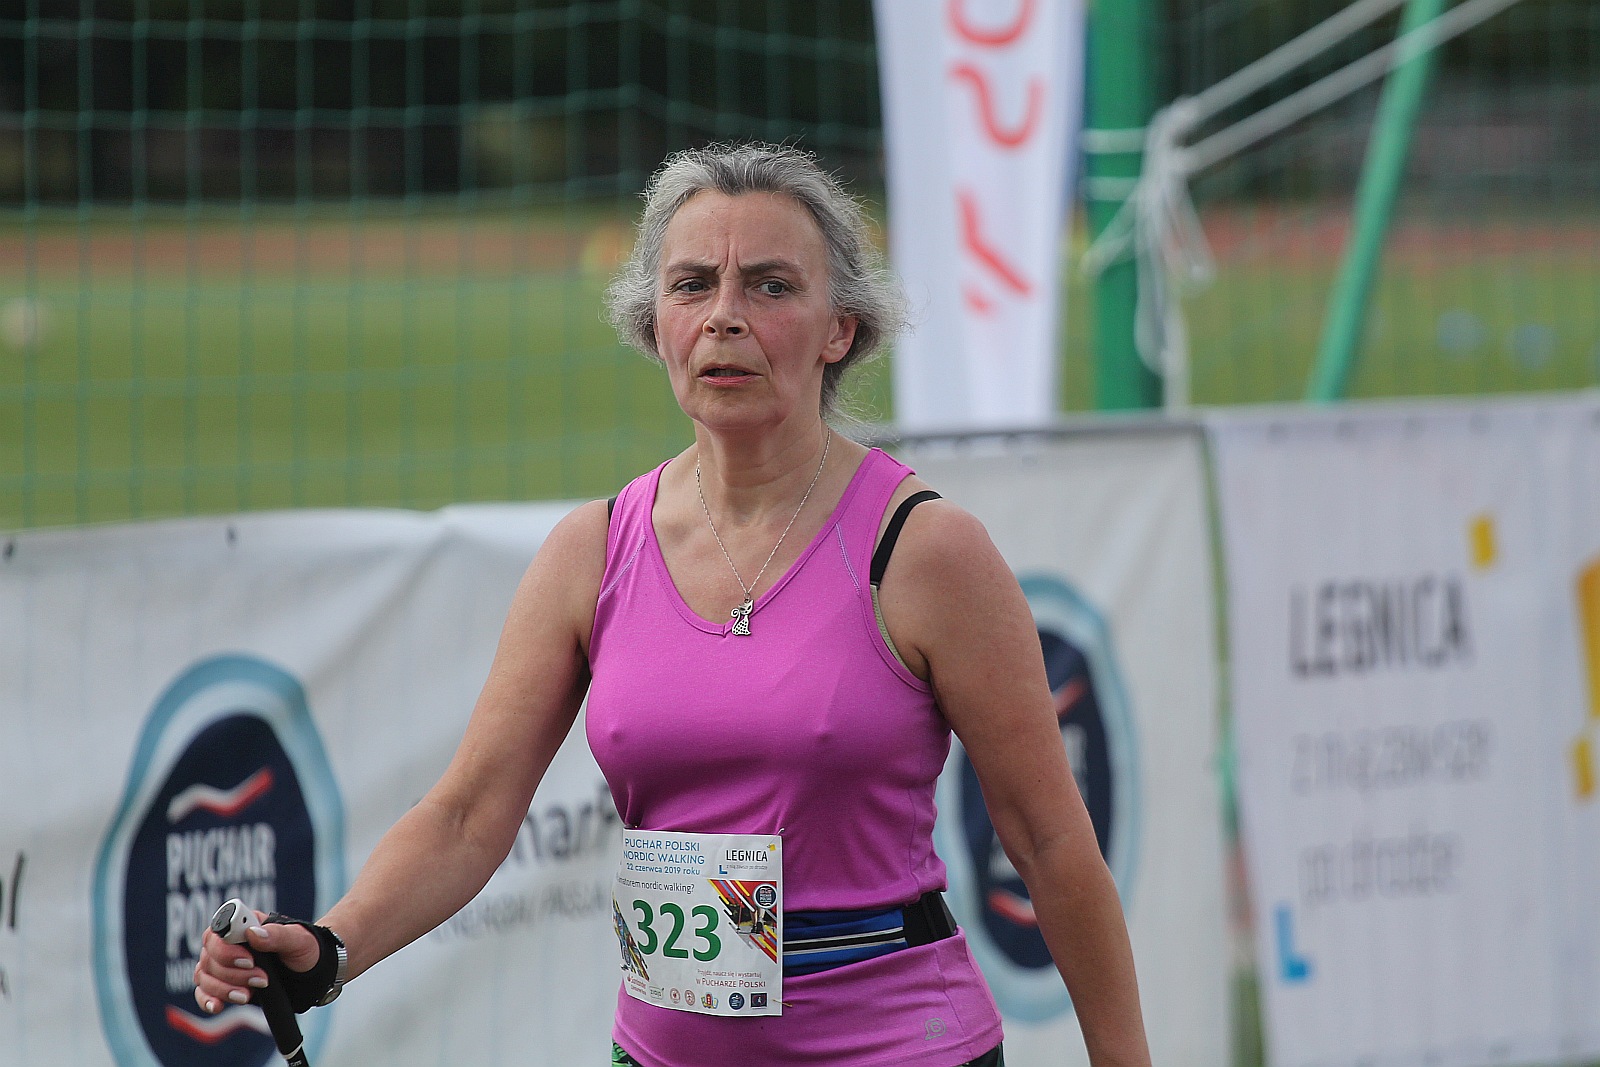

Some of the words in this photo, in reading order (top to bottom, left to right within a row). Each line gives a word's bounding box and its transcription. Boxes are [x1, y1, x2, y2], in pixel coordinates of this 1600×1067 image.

[1288, 574, 1477, 678] LEGNICA
[624, 838, 662, 850] PUCHAR
[665, 840, 700, 851] POLSKI
[165, 822, 277, 891] PUCHAR
[623, 850, 655, 862] NORDIC
[657, 853, 705, 864] WALKING
[726, 849, 768, 862] LEGNICA
[626, 862, 634, 870] 22
[635, 864, 663, 873] czerwca
[664, 866, 681, 874] 2019
[683, 867, 700, 876] roku
[642, 880, 662, 890] nordic
[664, 883, 695, 894] walking?
[633, 899, 721, 962] 323
[702, 977, 737, 988] PUCHARZE
[739, 980, 766, 988] POLSKI
